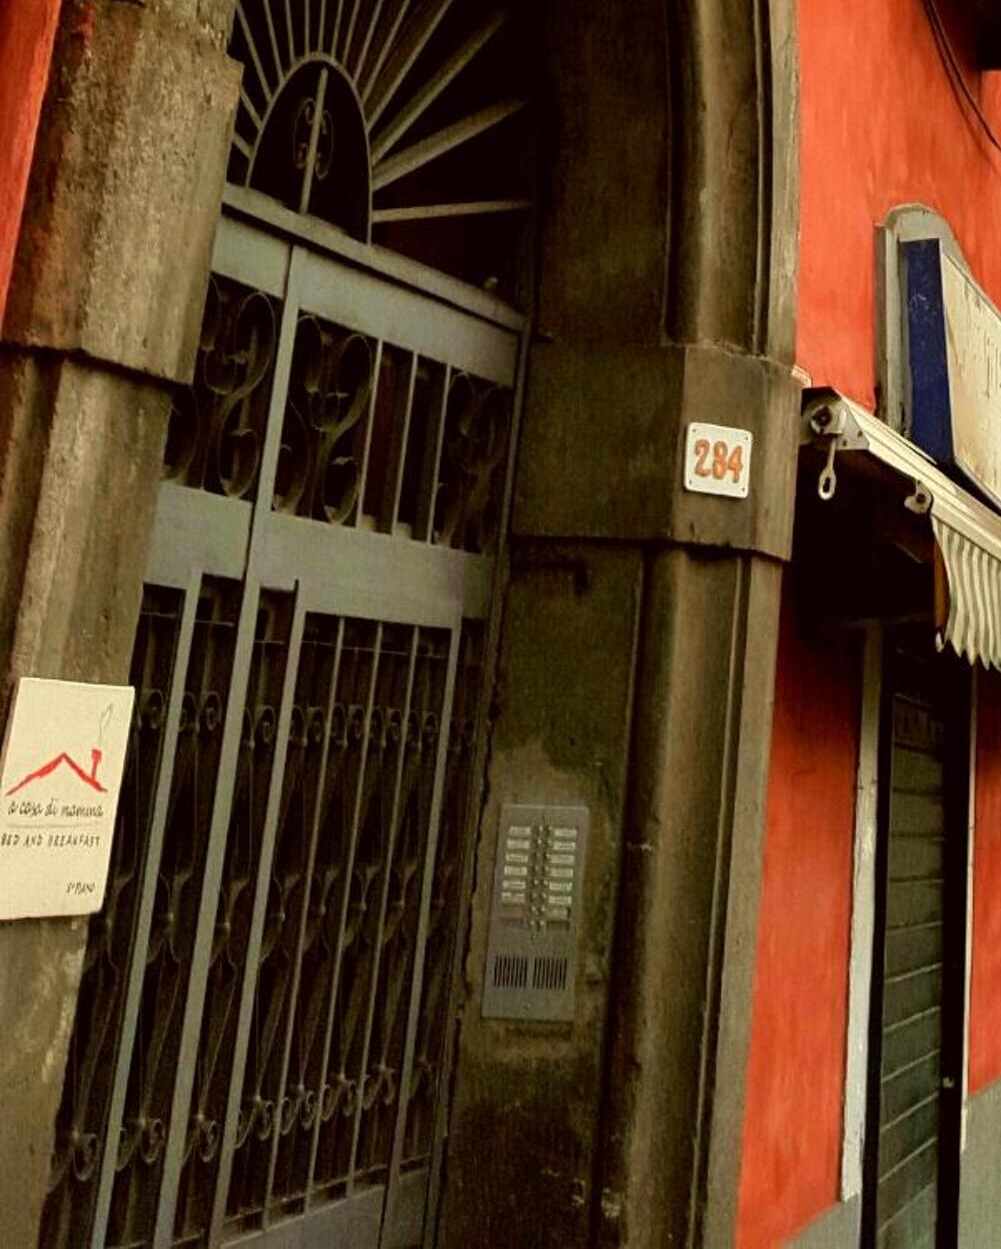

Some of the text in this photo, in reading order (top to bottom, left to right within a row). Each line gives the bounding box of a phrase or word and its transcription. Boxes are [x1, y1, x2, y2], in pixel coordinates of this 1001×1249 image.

[694, 438, 744, 484] 284
[1, 832, 101, 849] BED AND BREAKFAST
